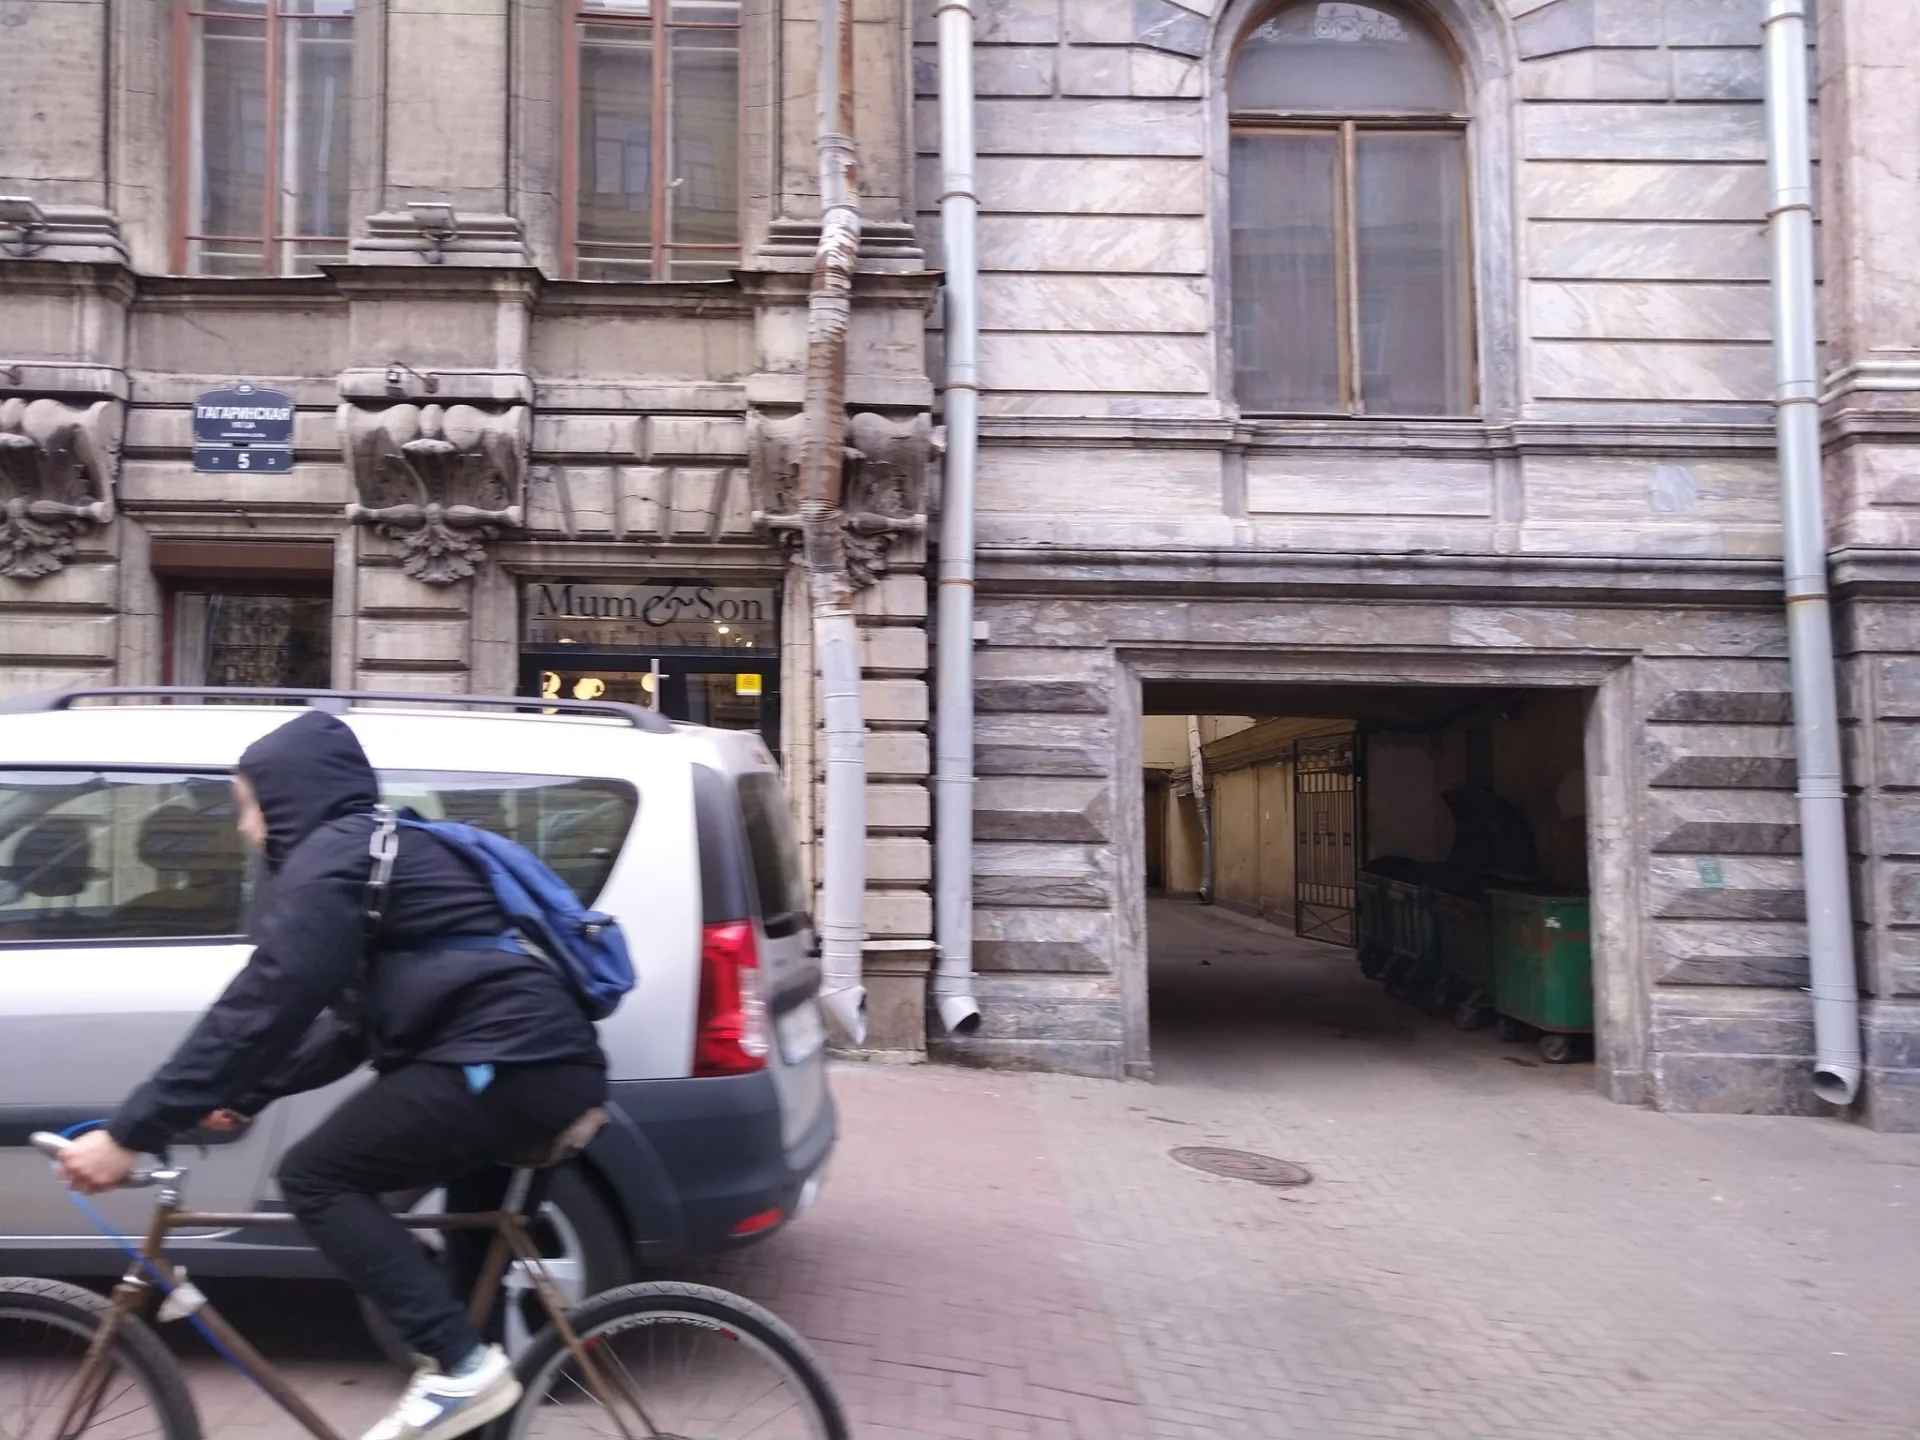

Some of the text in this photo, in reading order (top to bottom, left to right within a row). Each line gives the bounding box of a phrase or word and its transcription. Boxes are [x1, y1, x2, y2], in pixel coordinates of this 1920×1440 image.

[238, 453, 250, 469] 5
[538, 584, 641, 618] Mum
[696, 587, 764, 620] Son
